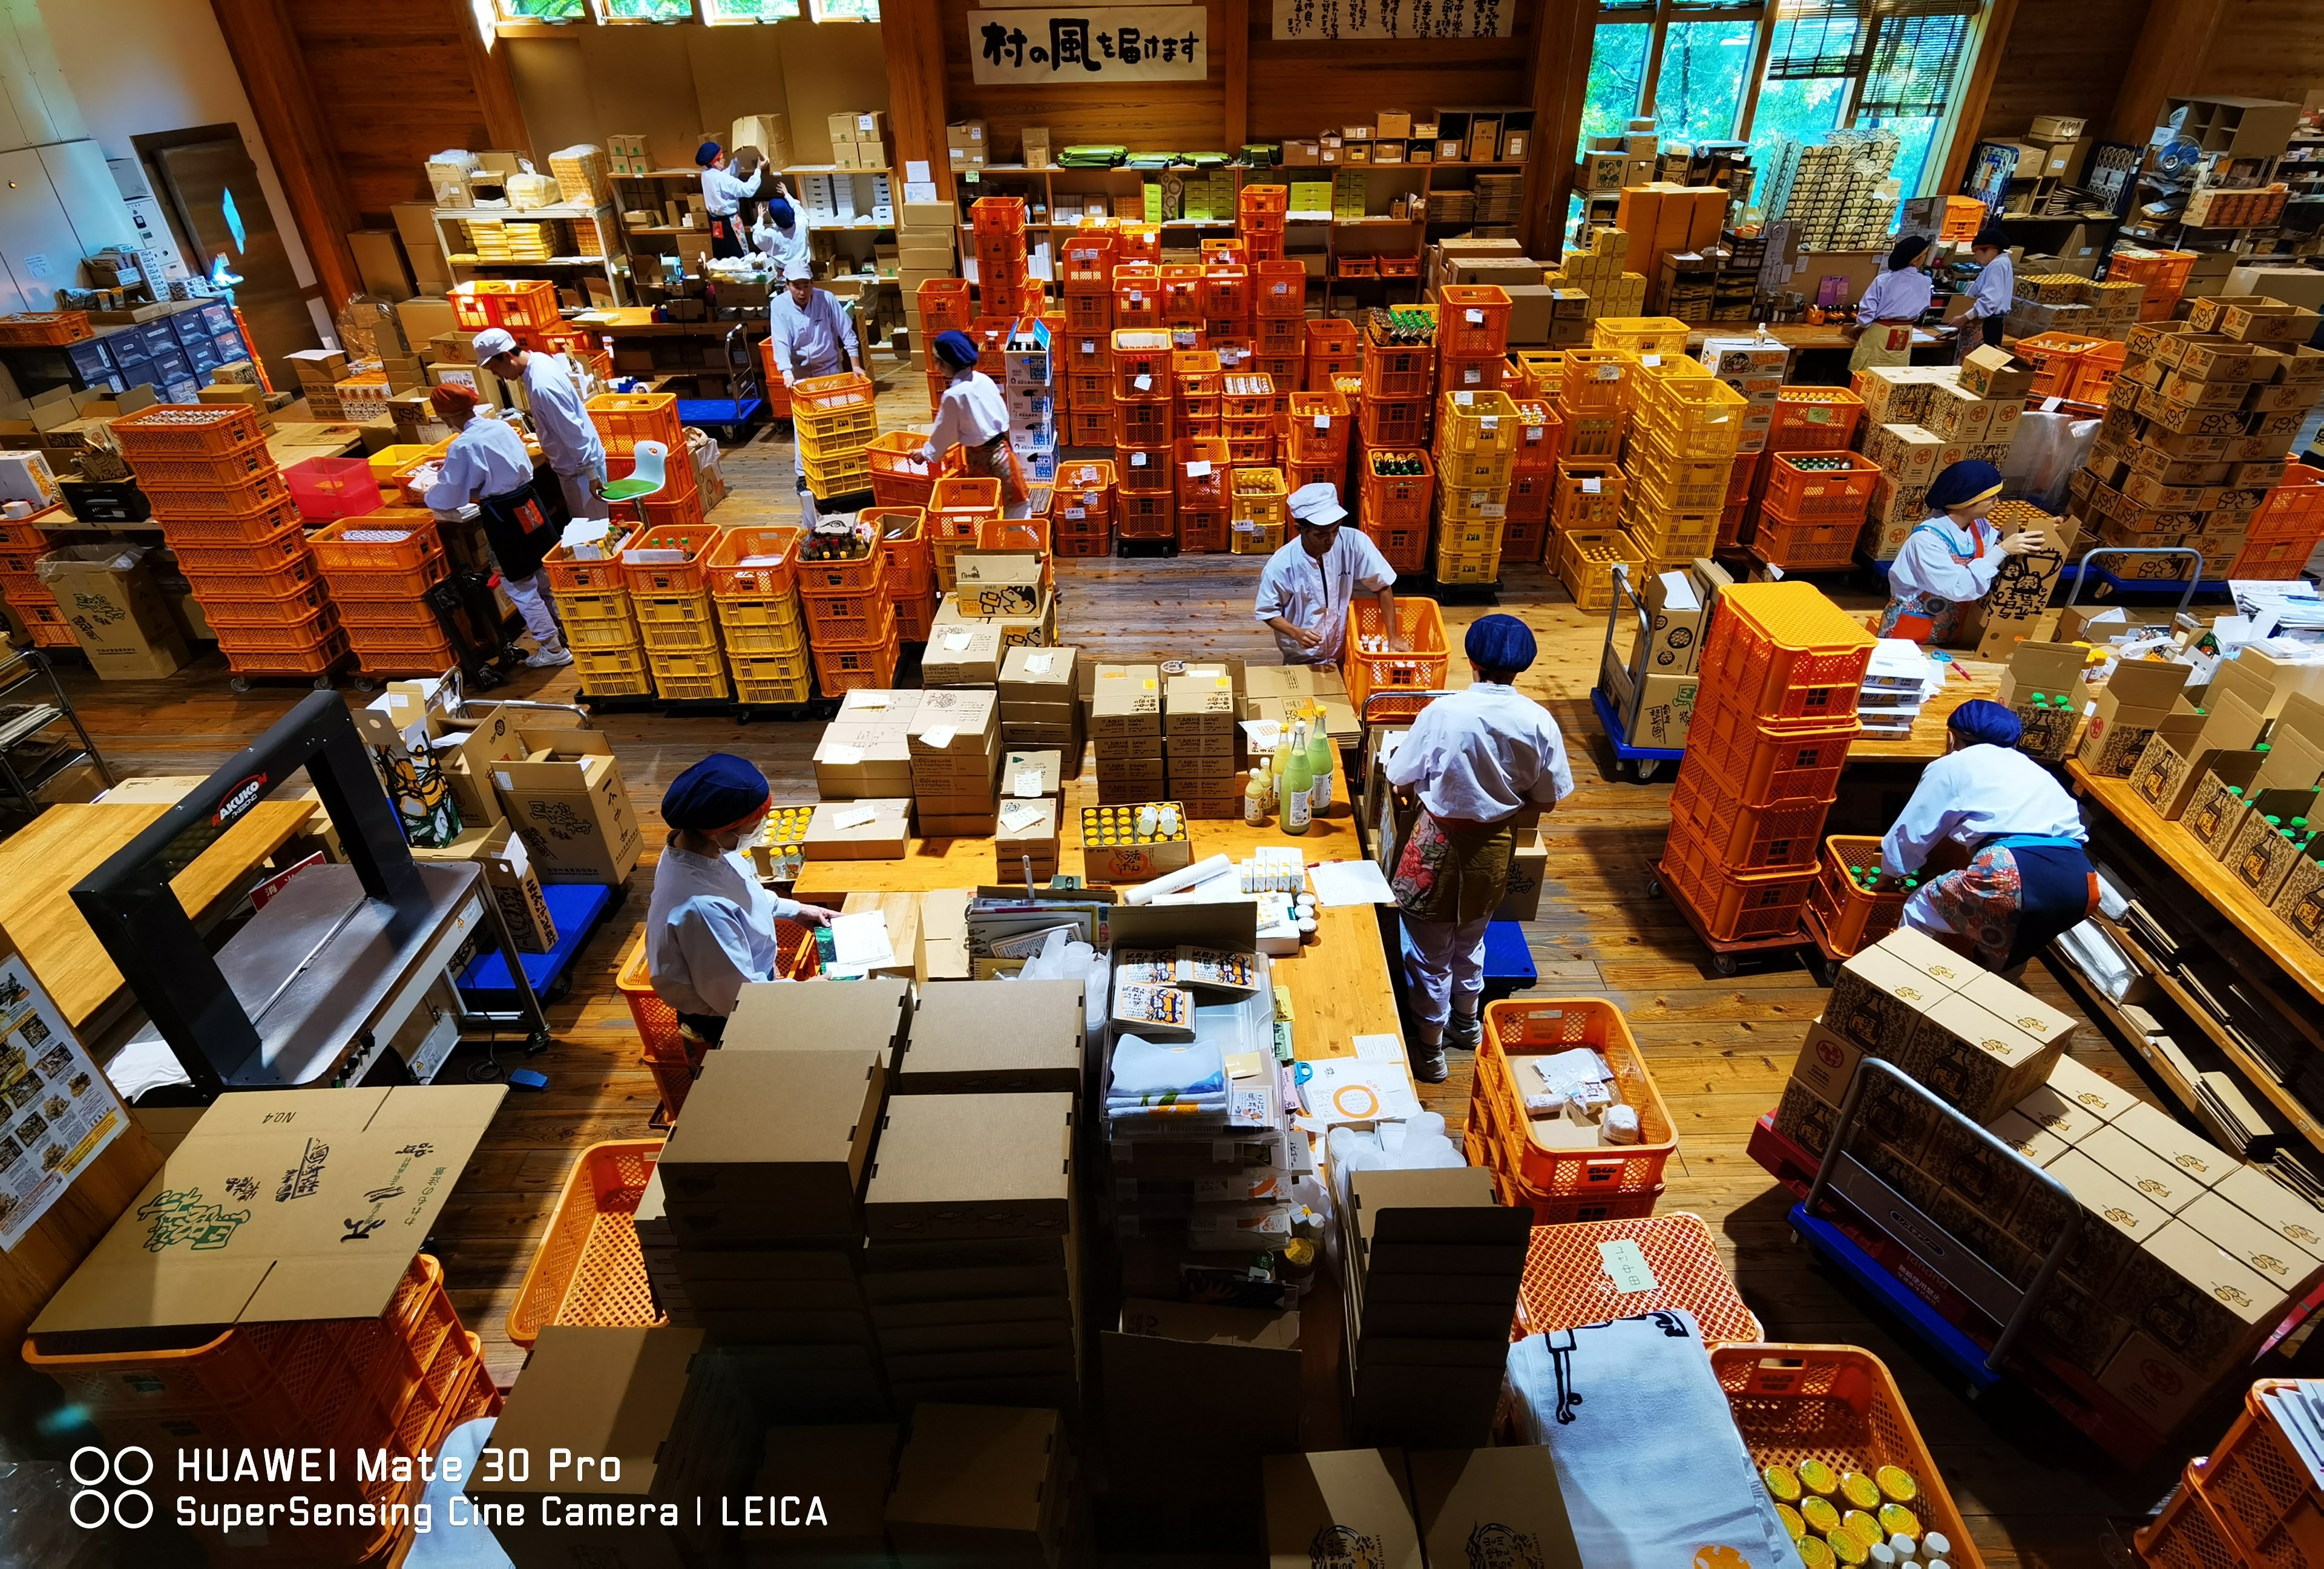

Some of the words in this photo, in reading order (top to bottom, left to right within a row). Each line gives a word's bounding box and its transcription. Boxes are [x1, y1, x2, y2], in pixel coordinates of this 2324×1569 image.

[981, 17, 1200, 72] 村の風を届けます
[211, 772, 268, 827] RAKUKON
[263, 1111, 297, 1123] NO.4
[404, 1166, 447, 1226] われもの注意
[1614, 1245, 1642, 1286] 田中さん
[1898, 1263, 1942, 1303] 無断使用禁止
